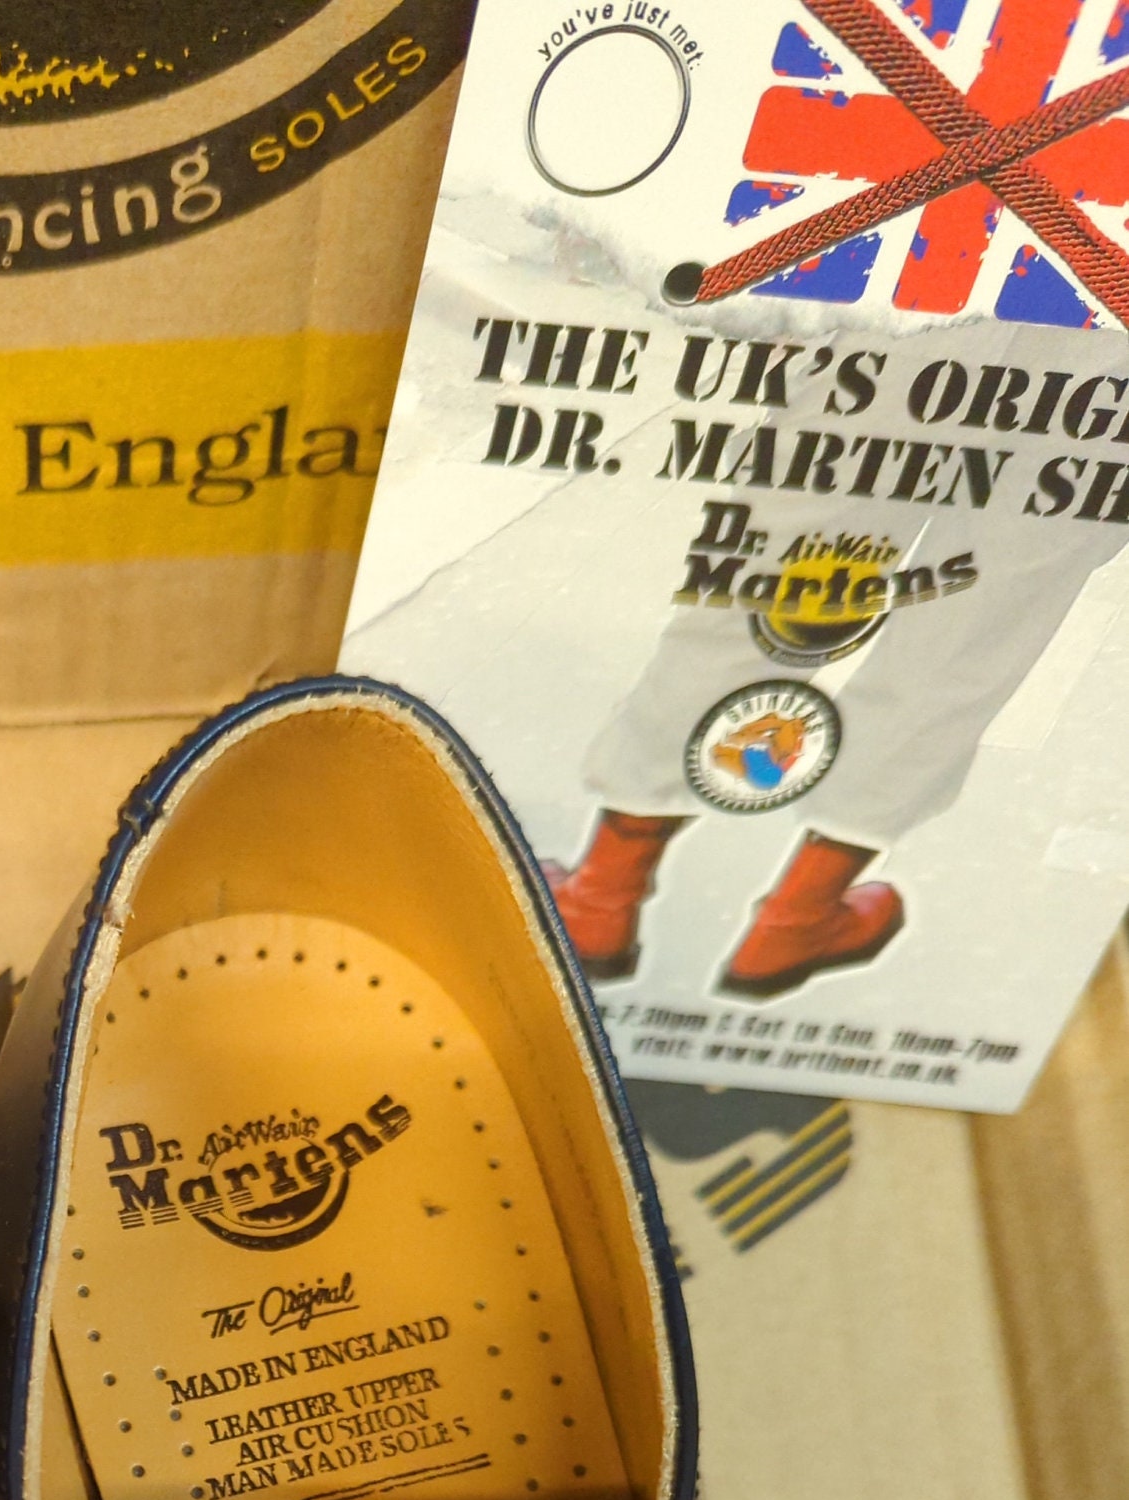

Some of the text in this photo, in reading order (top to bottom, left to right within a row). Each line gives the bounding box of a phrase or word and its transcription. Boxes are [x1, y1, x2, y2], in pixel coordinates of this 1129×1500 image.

[538, 3, 614, 61] you've
[623, 0, 669, 29] just
[250, 35, 428, 174] SOLES
[472, 318, 650, 396] THE
[673, 335, 888, 417] UK'S
[14, 405, 383, 509] Engla
[480, 404, 621, 476] DR.
[654, 420, 1014, 510] MARTEN
[690, 500, 768, 556] Dr.
[778, 531, 900, 565] AirWair
[671, 551, 979, 614] Martens
[99, 1123, 184, 1172] Dr.
[109, 1093, 412, 1231] Martens
[202, 1271, 361, 1339] The Original
[165, 1315, 451, 1406] MADE IN ENGLAND
[205, 1366, 442, 1445] LEATHER UPPER
[235, 1399, 430, 1468] AIR CUSHION
[281, 1443, 378, 1483] MADE
[381, 1415, 473, 1459] SOLES
